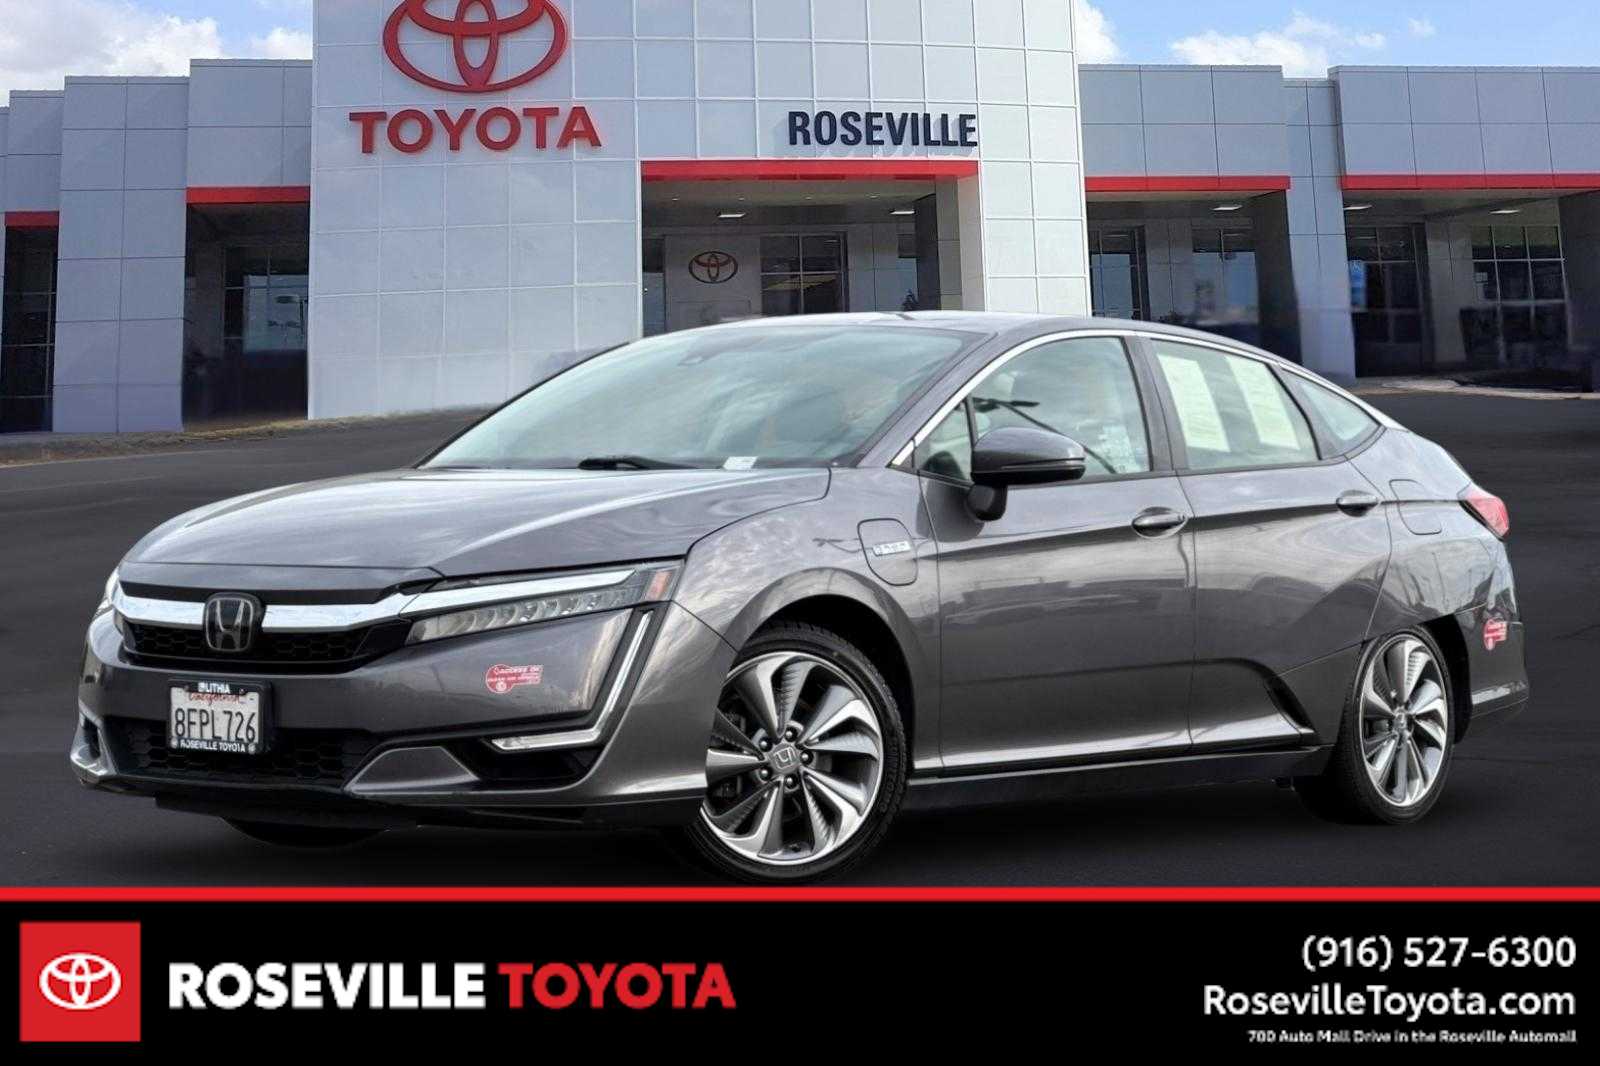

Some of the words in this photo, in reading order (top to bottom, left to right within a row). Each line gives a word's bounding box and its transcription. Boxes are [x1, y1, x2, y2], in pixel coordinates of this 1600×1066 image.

[349, 105, 601, 154] TOYOTA
[788, 111, 978, 147] ROSEVILLE
[180, 739, 218, 751] ROSEVILLE
[219, 742, 246, 753] TOYOTA
